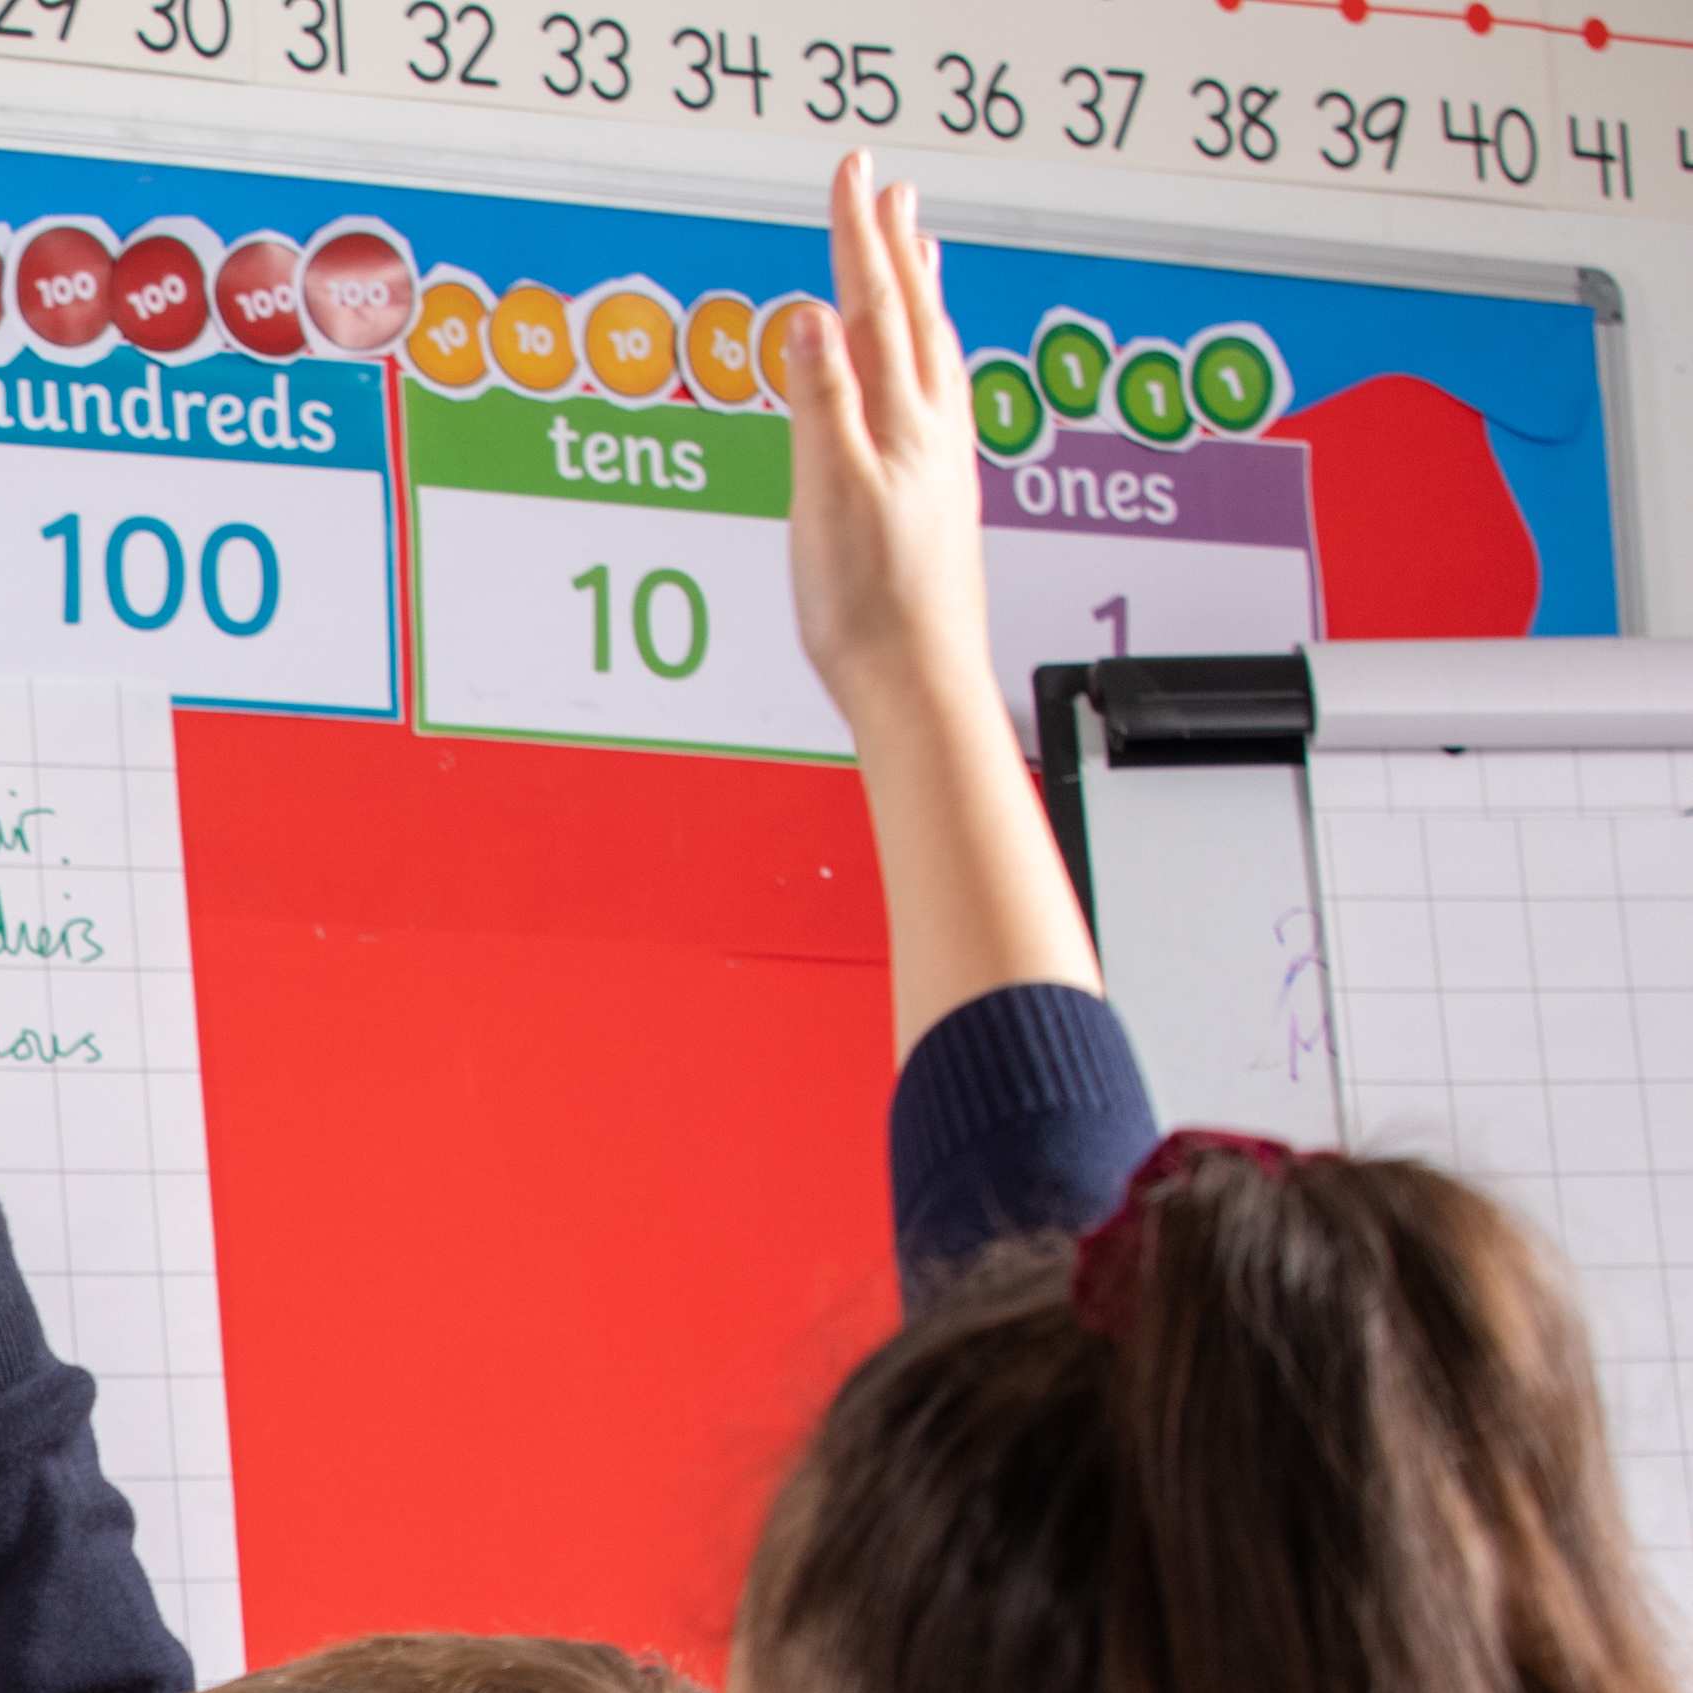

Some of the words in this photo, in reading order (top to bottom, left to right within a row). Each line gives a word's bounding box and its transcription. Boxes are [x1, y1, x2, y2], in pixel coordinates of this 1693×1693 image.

[137, 0, 232, 59] 30
[285, 0, 348, 76] 31
[406, 2, 500, 89] 32
[540, 12, 633, 102] 33
[670, 27, 773, 117] 34
[801, 41, 901, 125] 35
[935, 54, 1027, 141] 36
[1060, 66, 1148, 150] 37
[1189, 79, 1281, 163] 38
[1315, 92, 1408, 172] 39
[1439, 98, 1541, 187] 40
[1568, 114, 1634, 201] 41
[35, 270, 98, 309] 100
[127, 274, 187, 321] 100
[236, 284, 295, 323] 100
[325, 278, 391, 308] 100
[426, 315, 470, 358] 10
[514, 320, 555, 358] 10
[607, 326, 653, 363] 10
[710, 326, 746, 371] 10
[1061, 352, 1085, 391] 1
[1218, 366, 1246, 404] 1
[995, 389, 1013, 428] 1
[1145, 379, 1167, 420] 1
[549, 416, 708, 493] tens
[1013, 462, 1178, 525] ones
[39, 512, 281, 639] 100
[570, 564, 711, 681] 10
